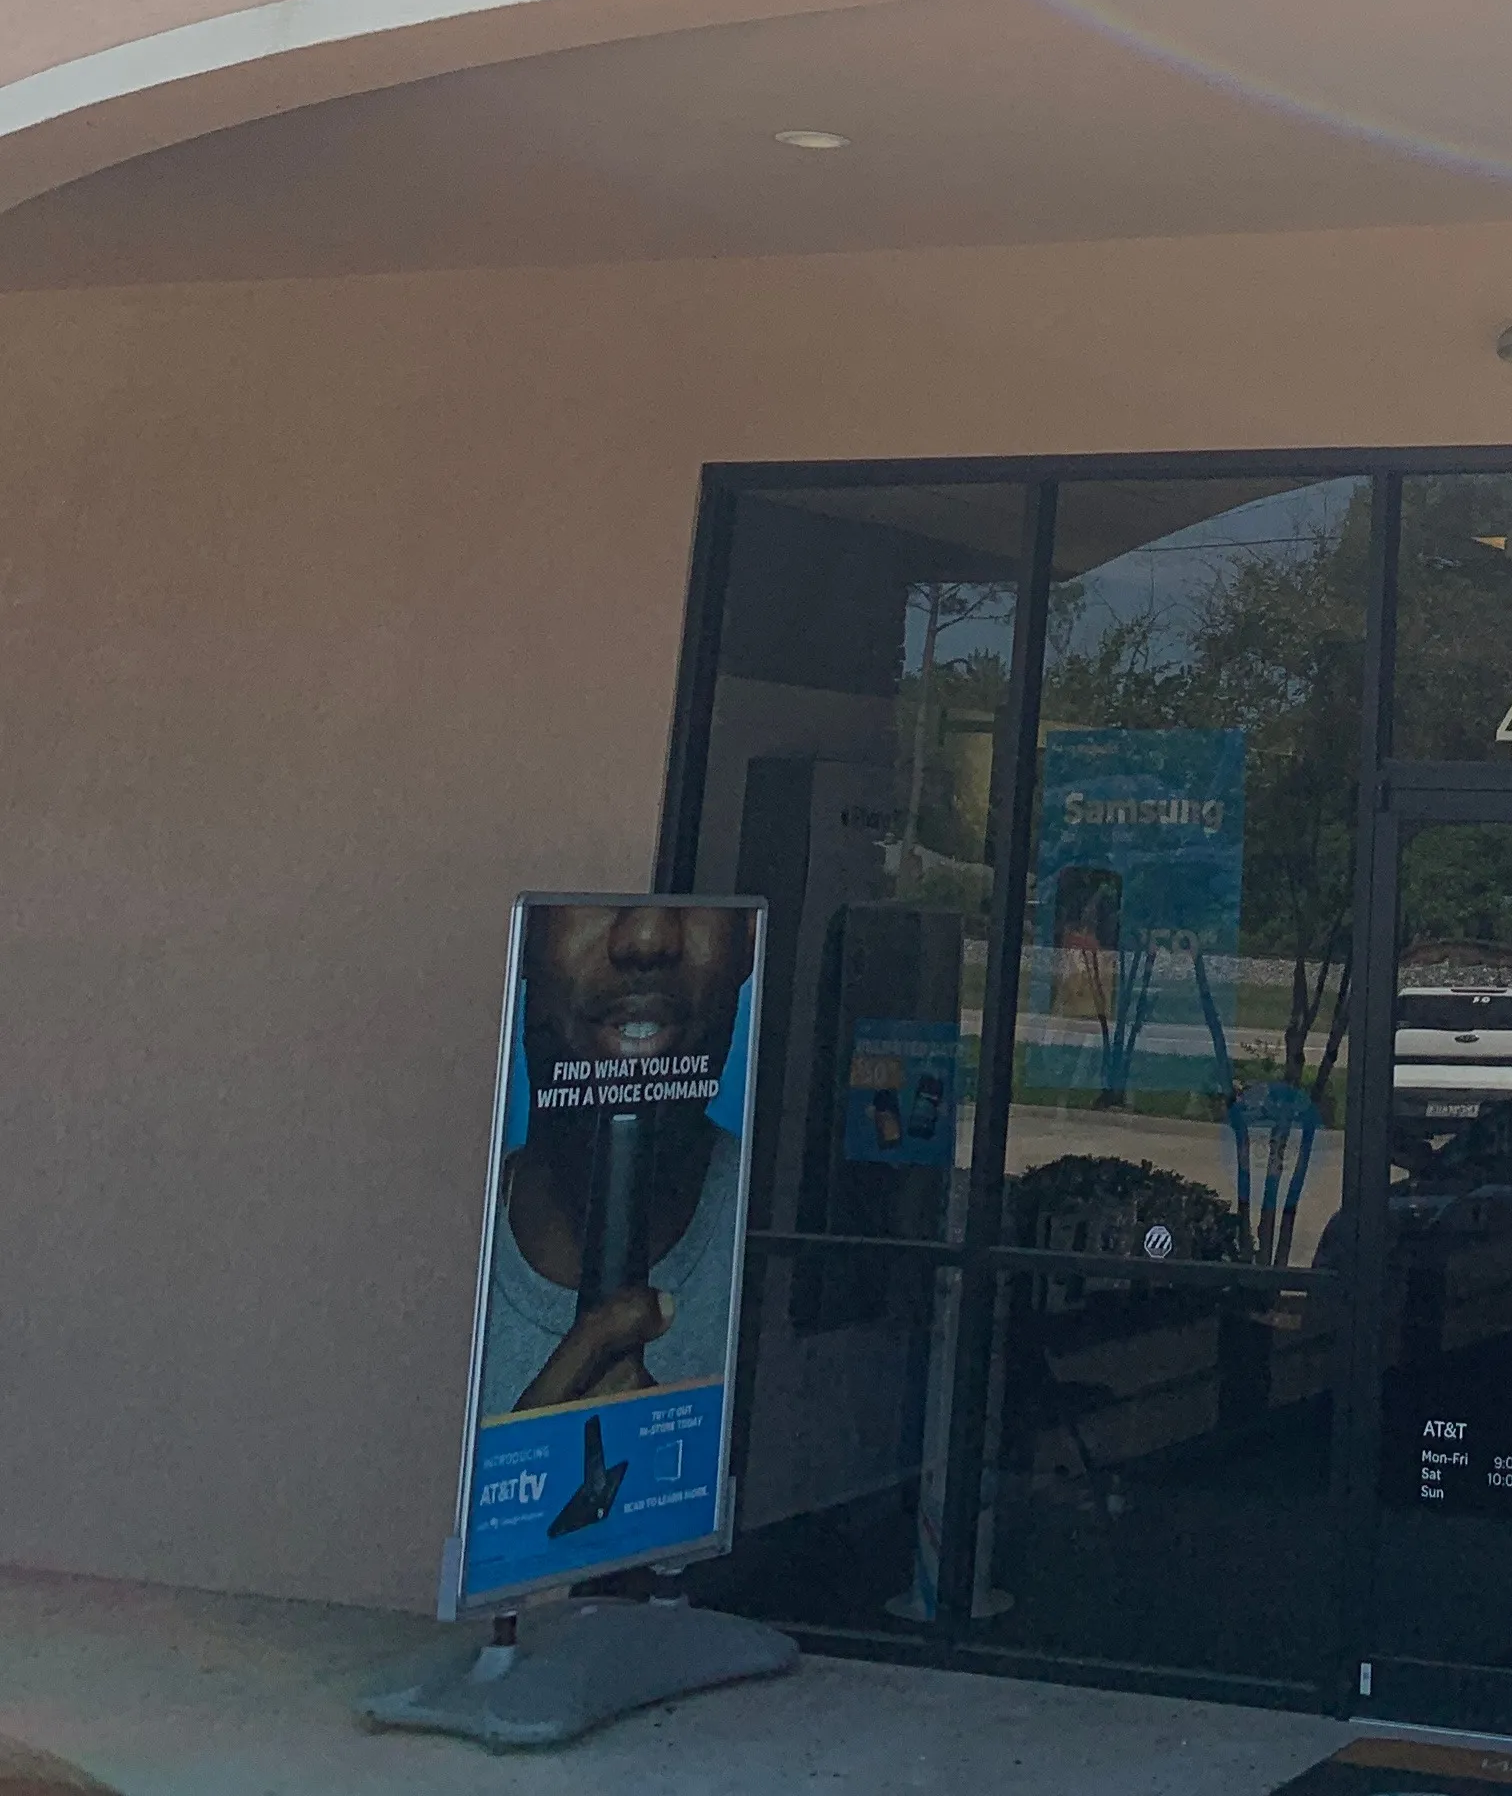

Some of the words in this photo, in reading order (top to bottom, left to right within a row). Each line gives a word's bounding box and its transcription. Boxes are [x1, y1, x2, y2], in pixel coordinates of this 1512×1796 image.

[1065, 791, 1225, 834] Samsung
[553, 1061, 591, 1080] FIND
[595, 1059, 638, 1079] WHAT
[641, 1057, 670, 1076] YOU
[672, 1055, 709, 1075] LOVE
[537, 1088, 580, 1108] WITH
[582, 1086, 594, 1106] A
[598, 1084, 642, 1105] VOICE
[644, 1079, 720, 1102] COMMAND
[1423, 1420, 1467, 1440] AT&T
[1421, 1450, 1469, 1466] Mon-Fri
[1421, 1467, 1442, 1481] Sat
[1421, 1485, 1444, 1500] Sun
